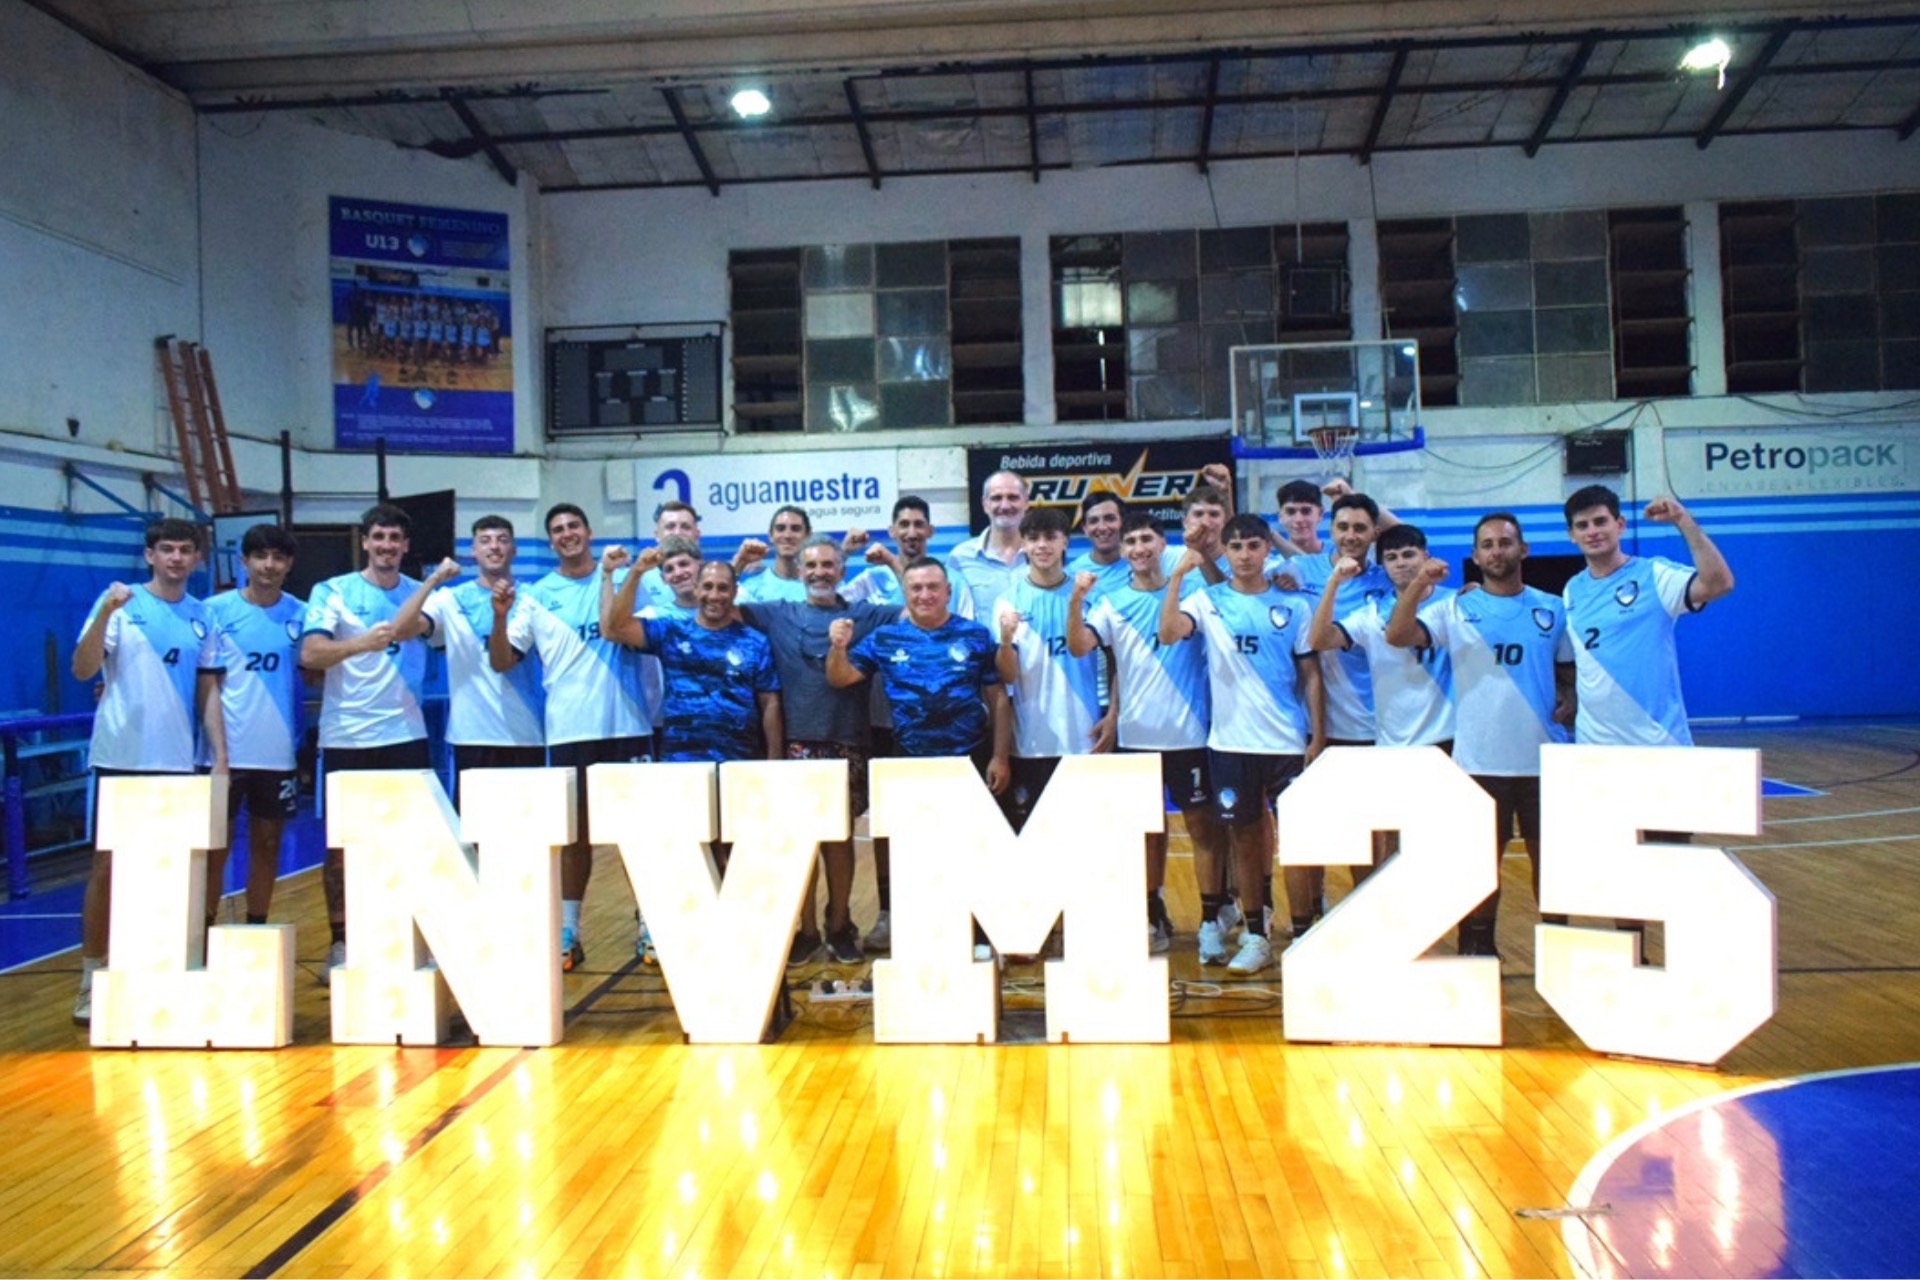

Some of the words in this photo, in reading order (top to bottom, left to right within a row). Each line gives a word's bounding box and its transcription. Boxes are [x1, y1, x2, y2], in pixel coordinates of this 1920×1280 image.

[340, 207, 415, 226] BASQUET
[418, 215, 501, 235] FEMENINO
[364, 234, 400, 251] U13
[1000, 454, 1046, 470] Bebida
[1048, 451, 1112, 470] deportiva
[1705, 442, 1898, 474] Petropack
[709, 472, 881, 512] aguanuestra
[808, 506, 838, 518] agua
[840, 504, 882, 518] segura
[1046, 635, 1067, 657] 12
[1234, 634, 1259, 655] 15
[1584, 627, 1600, 650] 2
[163, 648, 181, 666] 4
[245, 652, 280, 672] 20
[1493, 643, 1524, 666] 10
[1189, 766, 1202, 788] 1
[90, 752, 1172, 1048] LNVM
[1276, 743, 1777, 1066] 25
